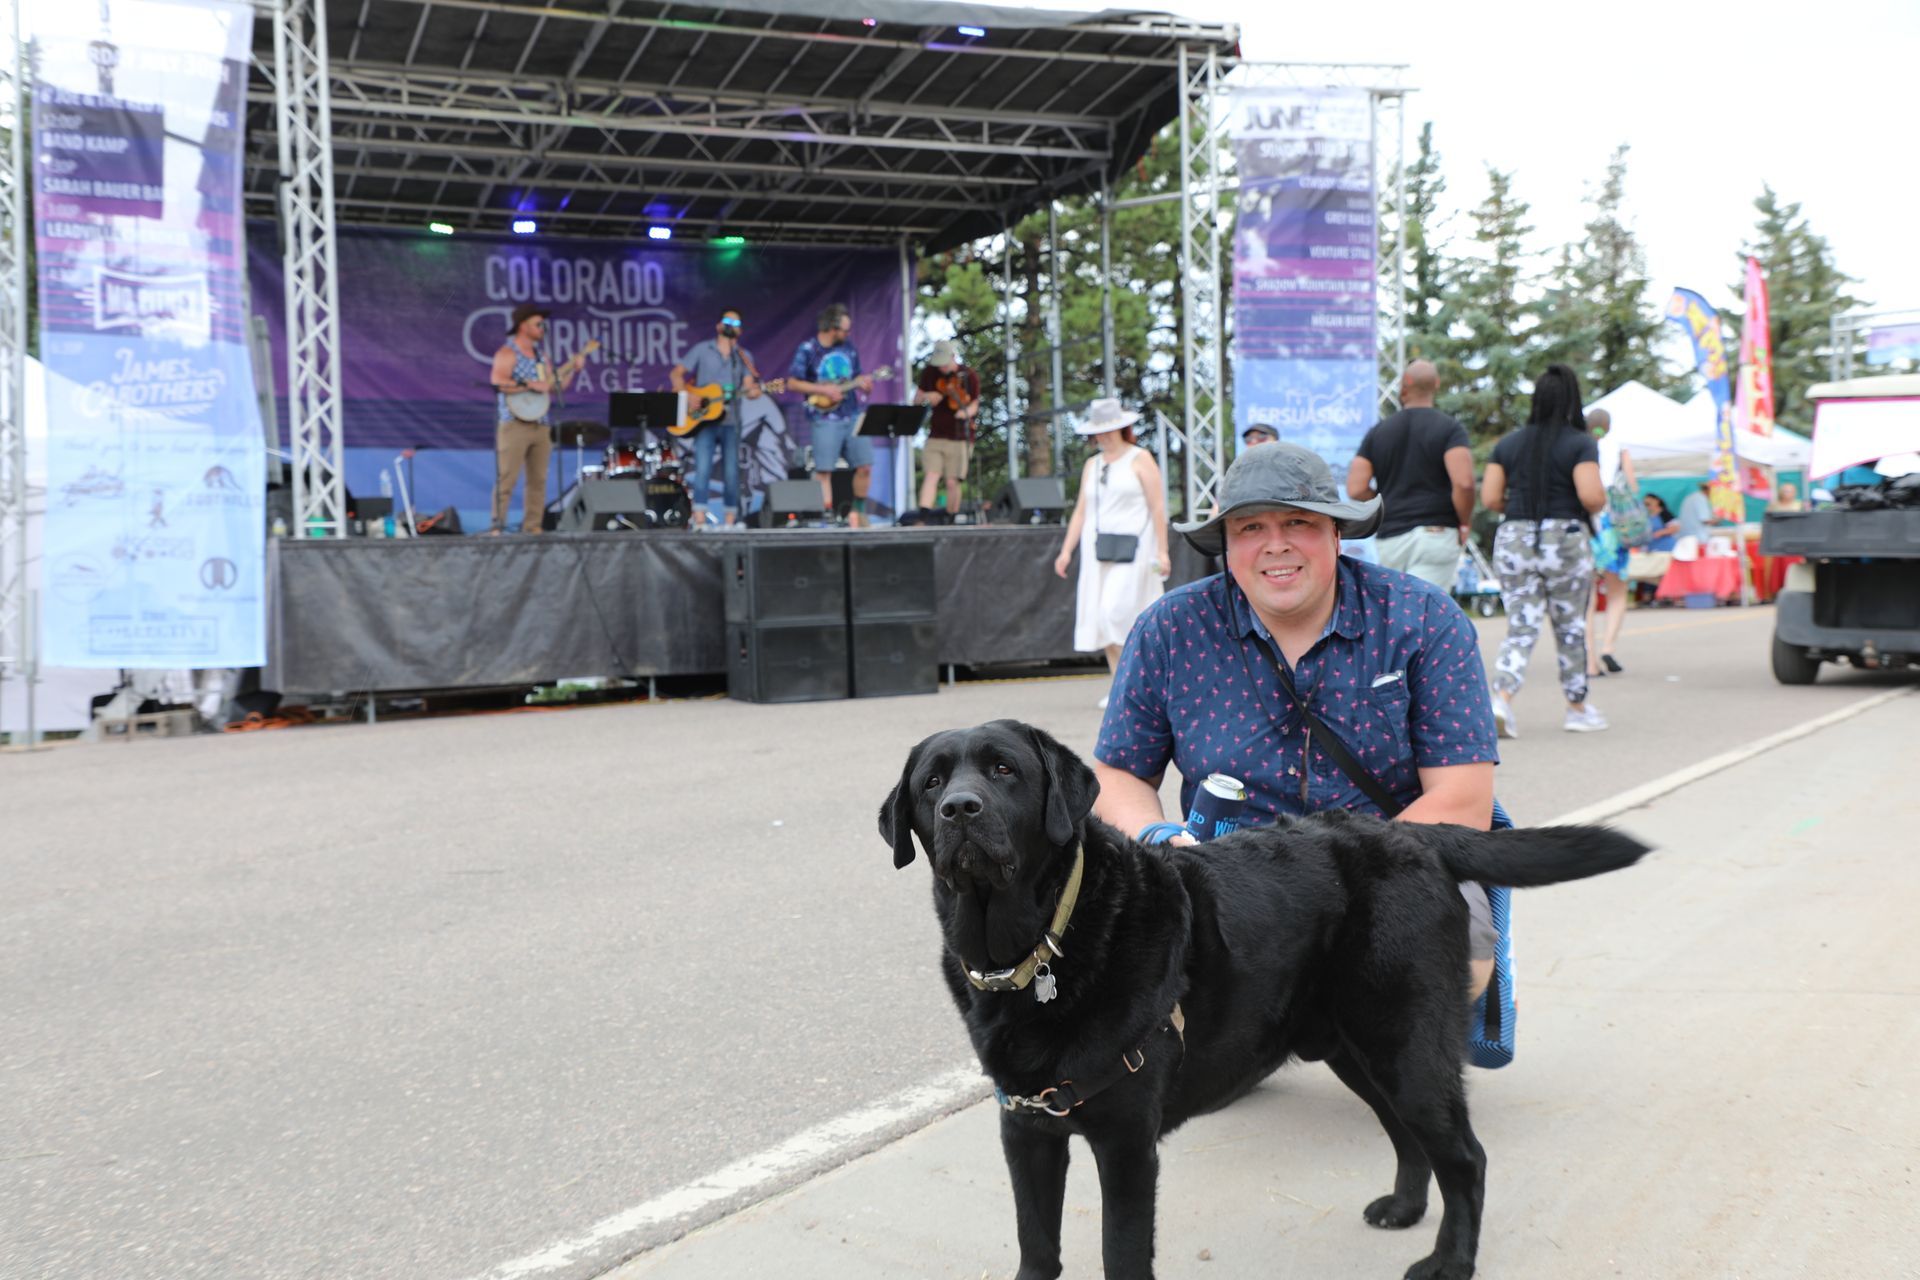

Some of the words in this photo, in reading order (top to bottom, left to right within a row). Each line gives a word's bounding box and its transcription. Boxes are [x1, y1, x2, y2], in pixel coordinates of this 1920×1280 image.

[42, 176, 91, 197] SARAH
[485, 255, 665, 305] COLORADO
[110, 346, 192, 385] JAMES
[575, 367, 643, 394] AGE
